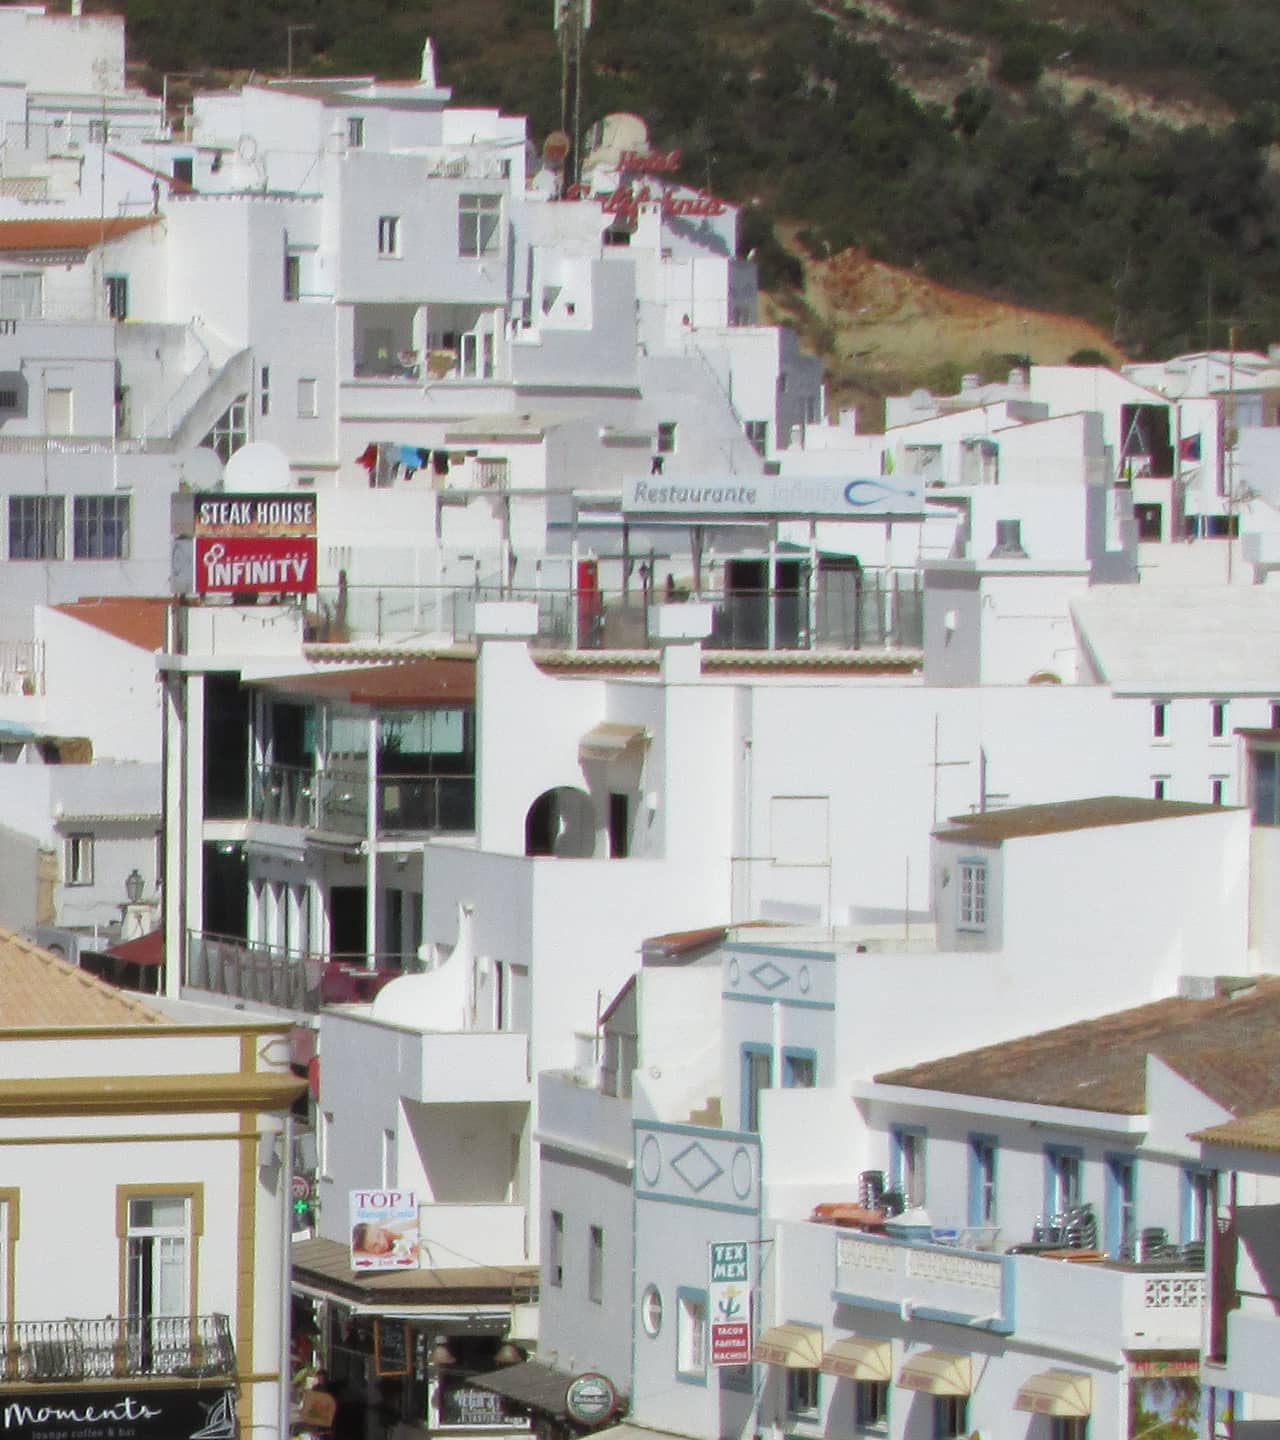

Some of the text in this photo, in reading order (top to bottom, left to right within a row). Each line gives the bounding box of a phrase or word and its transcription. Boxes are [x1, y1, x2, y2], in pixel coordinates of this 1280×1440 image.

[634, 480, 758, 505] Restaurante
[200, 501, 313, 525] STEAK HOUSE
[206, 557, 309, 587] INFINITY
[355, 1192, 416, 1208] TOP 1
[715, 1245, 744, 1261] TEX
[713, 1262, 746, 1278] MEX
[718, 1327, 744, 1335] TACOS
[4, 1397, 163, 1429] Moments
